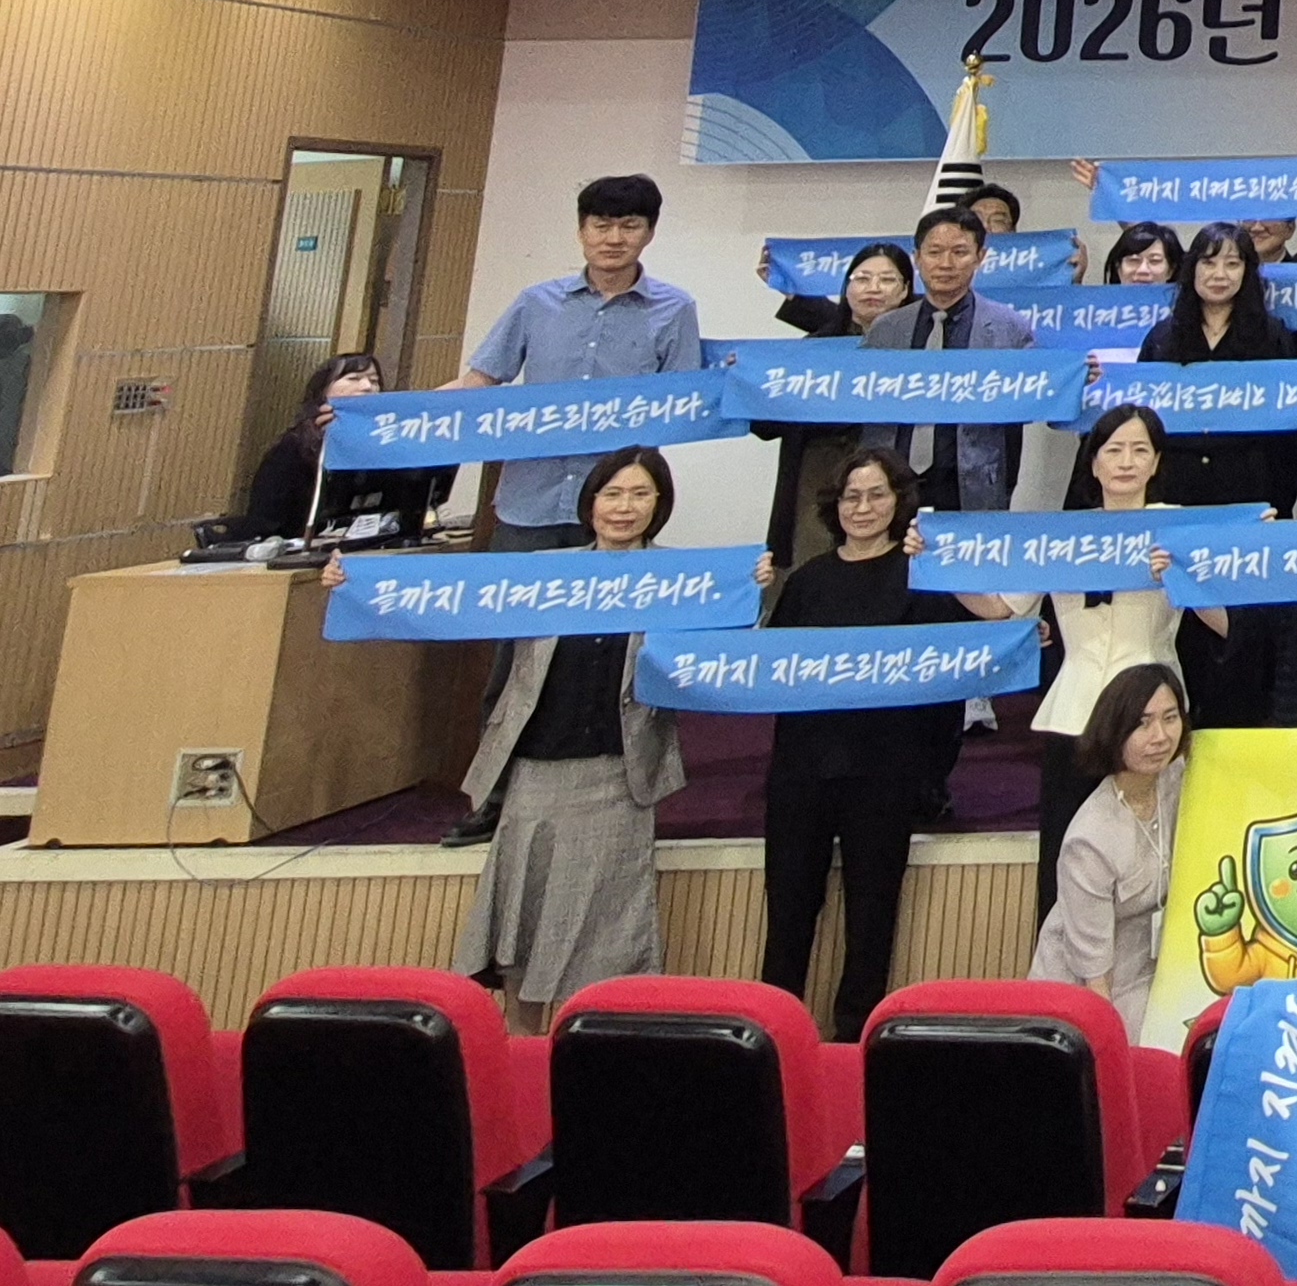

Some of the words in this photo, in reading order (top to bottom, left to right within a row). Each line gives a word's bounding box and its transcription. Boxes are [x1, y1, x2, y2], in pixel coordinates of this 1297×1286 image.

[1120, 176, 1181, 202] 끝까지
[798, 250, 850, 276] 끝까
[1016, 302, 1062, 332] 까지
[760, 367, 841, 401] 끝까지
[851, 369, 1054, 403] 지켜드리겠습니다.
[370, 410, 462, 445] 끝까지
[476, 391, 709, 438] 지켜드리겠습니다.
[932, 532, 1011, 567] 끝까지
[1021, 531, 1152, 565] 지켜드리겠
[1187, 546, 1270, 582] 끝까지
[369, 579, 465, 615] 끝까지
[477, 571, 721, 613] 지켜드리겠습니다.
[669, 653, 758, 688] 끝까지
[771, 645, 999, 687] 지켜드리겠습니다.
[1234, 1138, 1290, 1240] 까지
